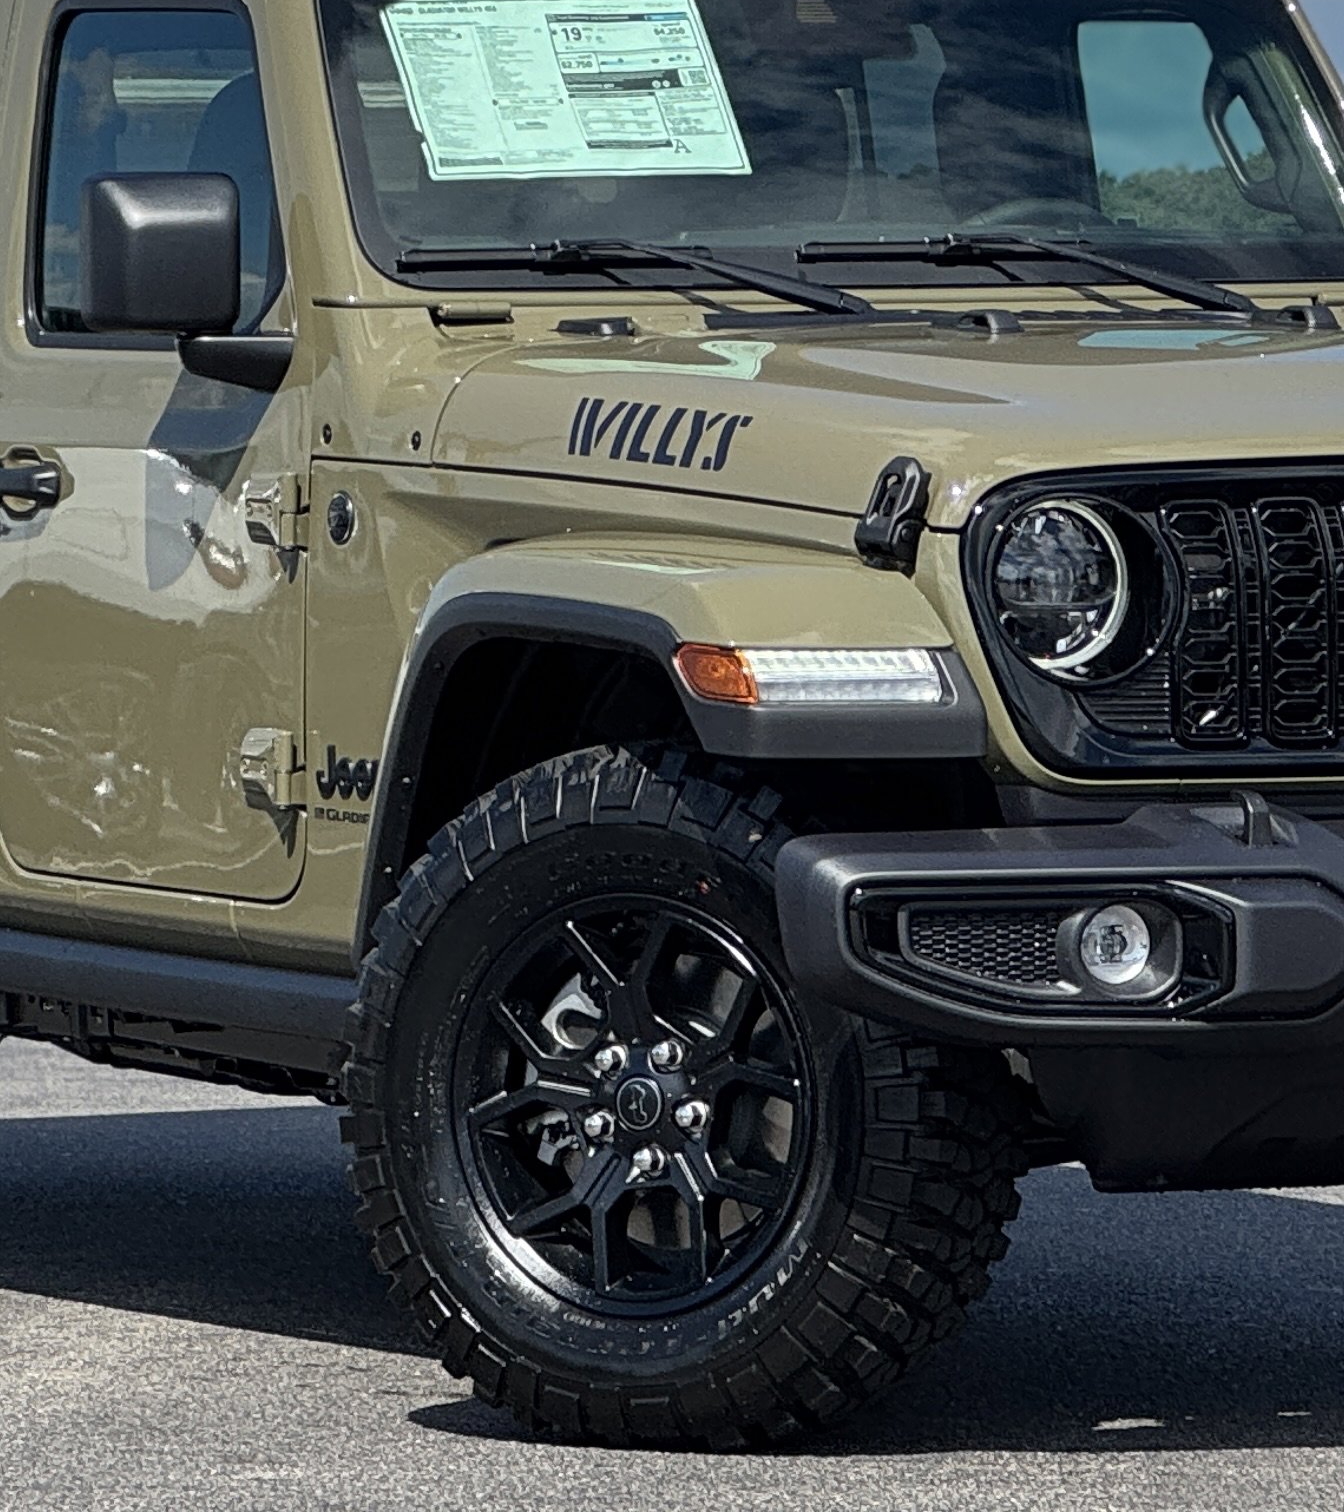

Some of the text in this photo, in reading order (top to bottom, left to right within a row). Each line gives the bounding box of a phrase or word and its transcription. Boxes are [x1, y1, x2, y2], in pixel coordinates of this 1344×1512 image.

[561, 26, 582, 41] 19
[673, 138, 692, 154] A
[567, 396, 754, 472] WILLYS
